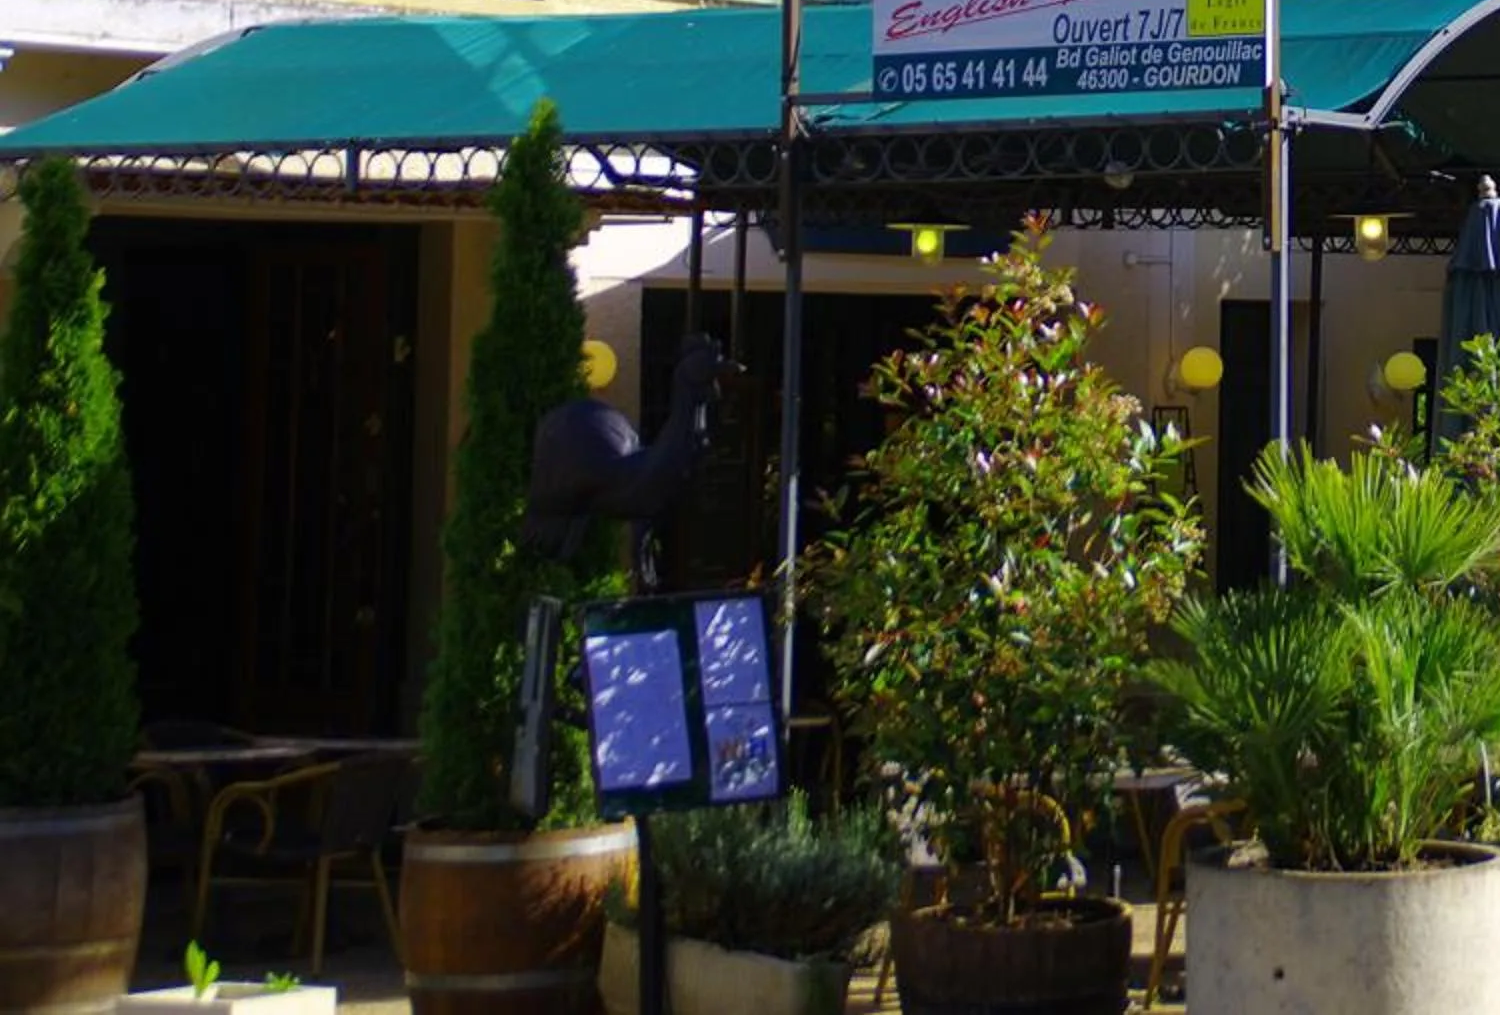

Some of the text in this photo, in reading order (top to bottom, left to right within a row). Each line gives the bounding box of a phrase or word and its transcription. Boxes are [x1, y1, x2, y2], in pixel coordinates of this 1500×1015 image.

[1053, 8, 1185, 44] Ouvert 7J/7
[1056, 39, 1263, 69] Bd Galiot de Genouillac
[902, 56, 1048, 94] 05 65 41 41 44
[1077, 67, 1129, 90] 46300
[1144, 63, 1241, 86] GOURDON
